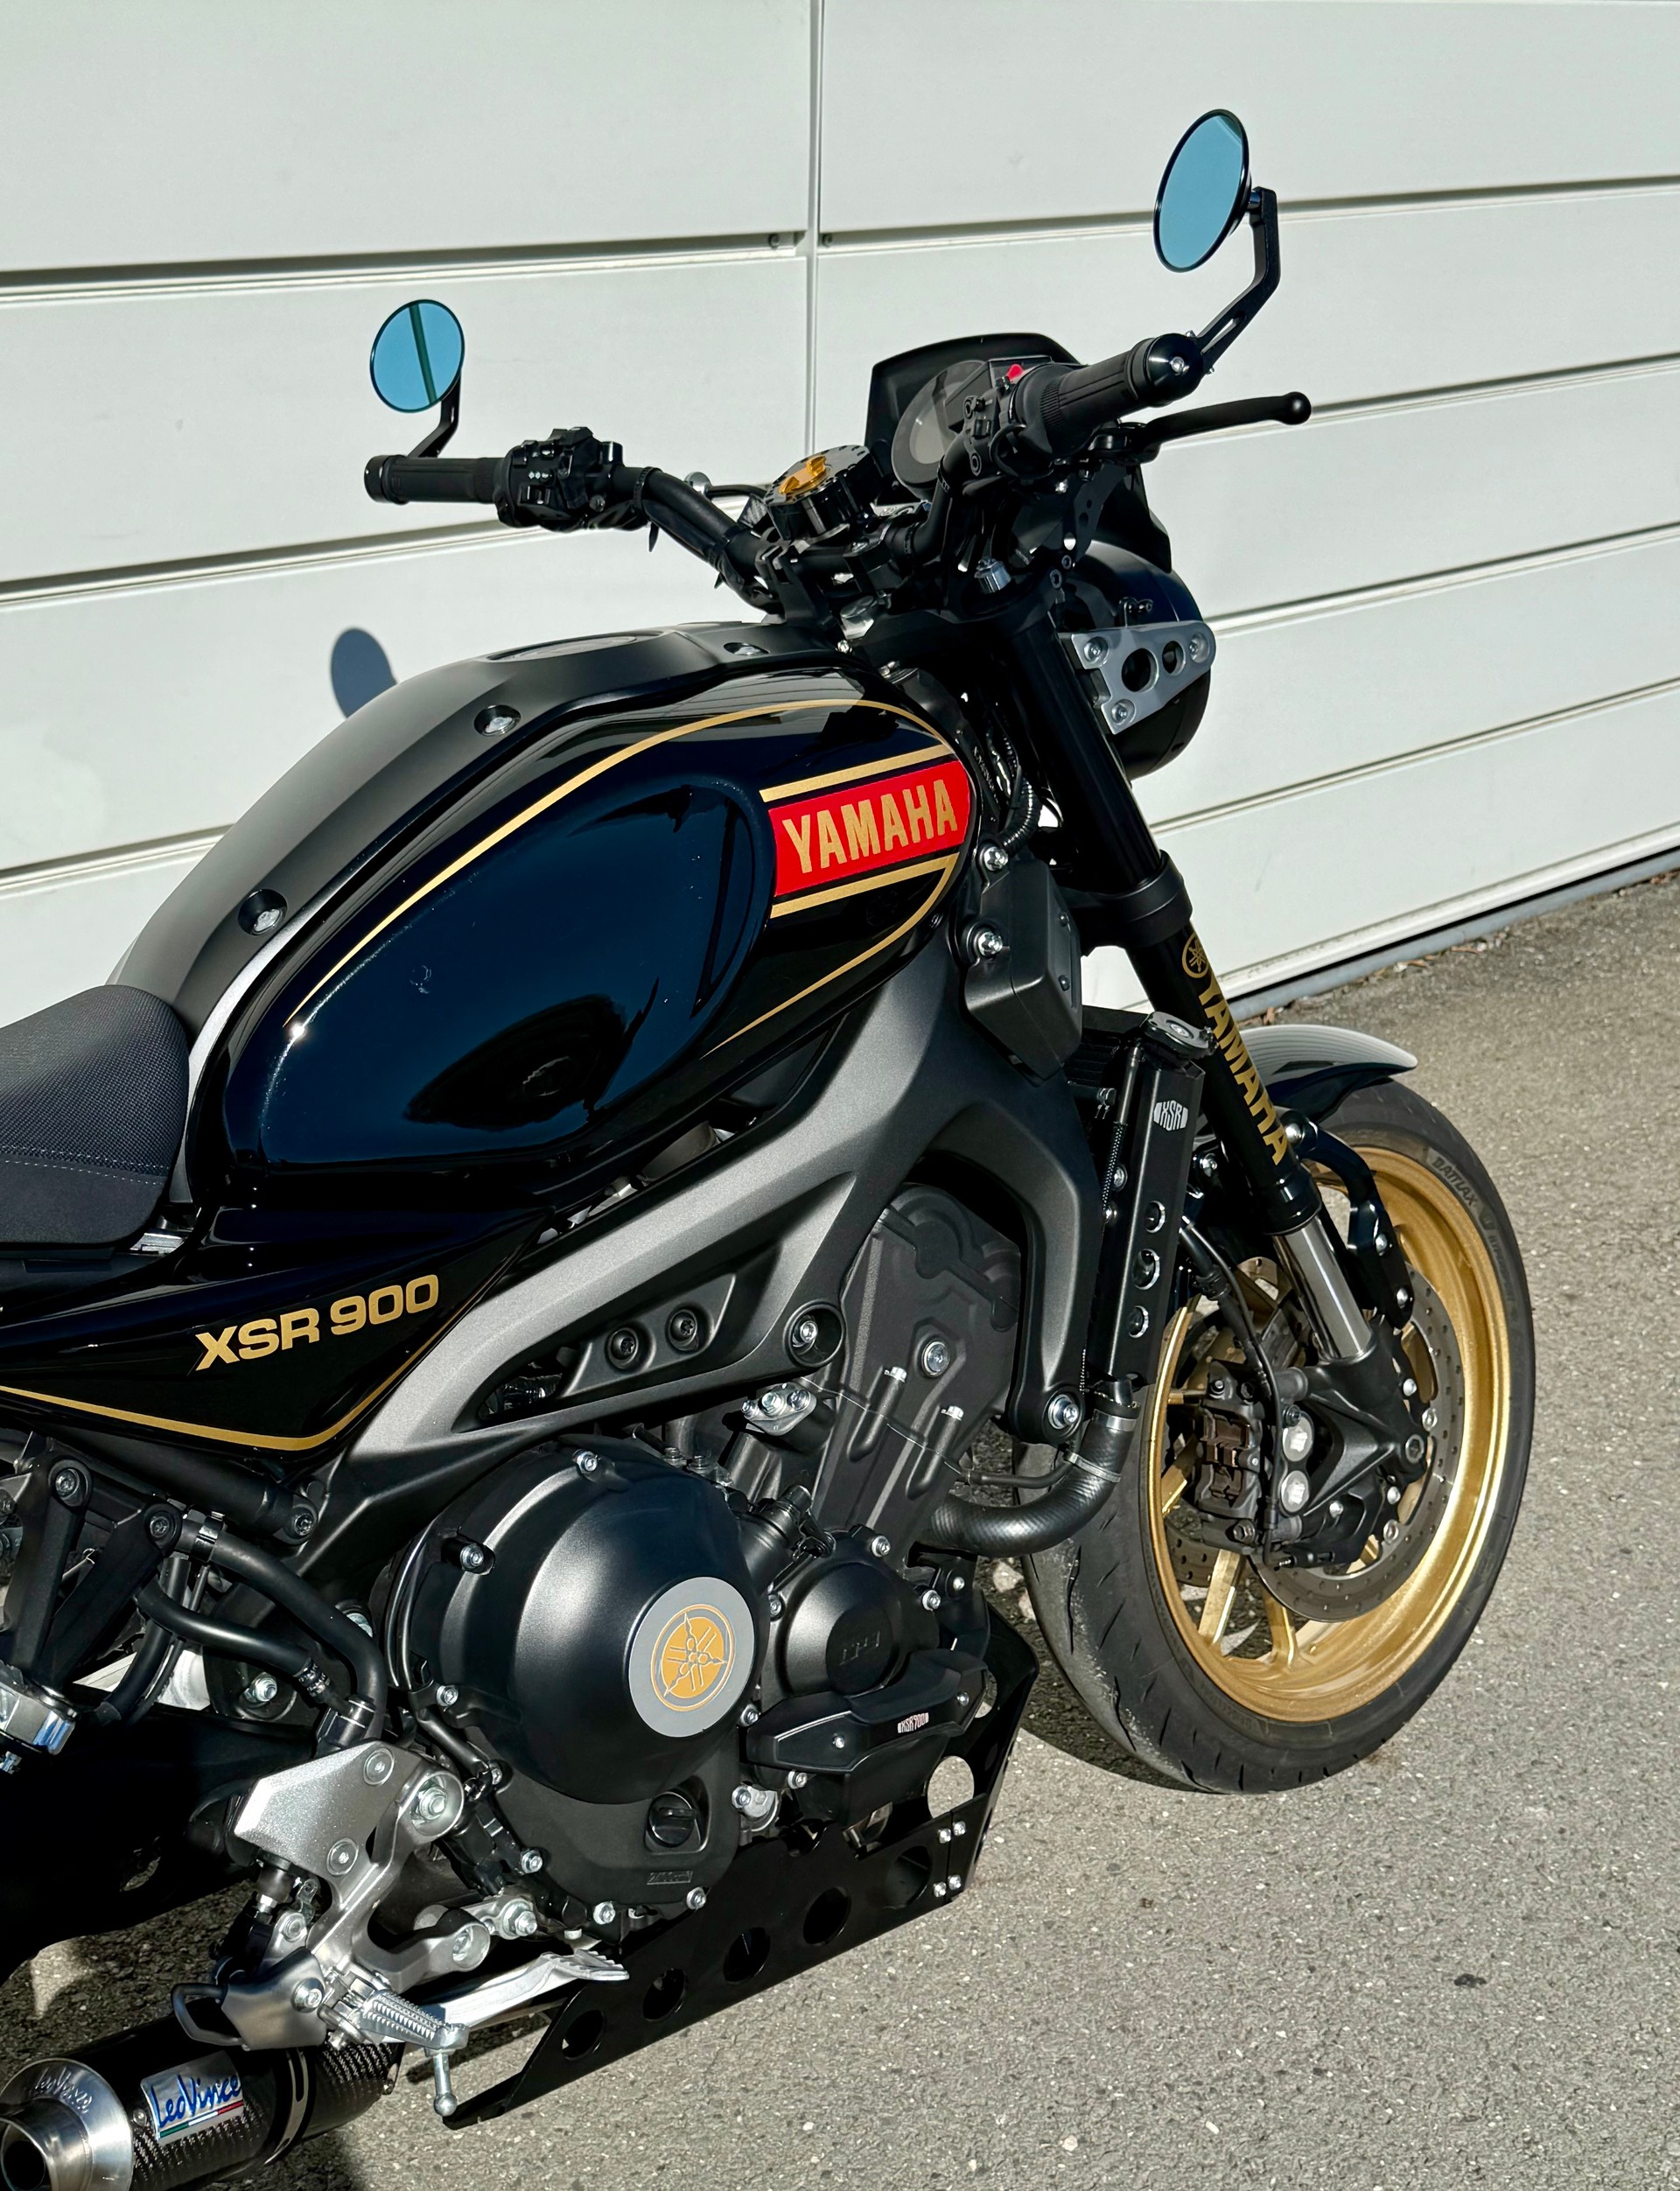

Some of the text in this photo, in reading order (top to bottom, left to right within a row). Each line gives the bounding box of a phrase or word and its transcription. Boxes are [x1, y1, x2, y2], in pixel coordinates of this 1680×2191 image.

[782, 779, 957, 873] YAMAHA
[1160, 1100, 1183, 1130] XSR
[1199, 973, 1288, 1166] YAMAHA
[195, 1274, 438, 1371] XSR 900
[150, 2074, 242, 2128] LeoVince
